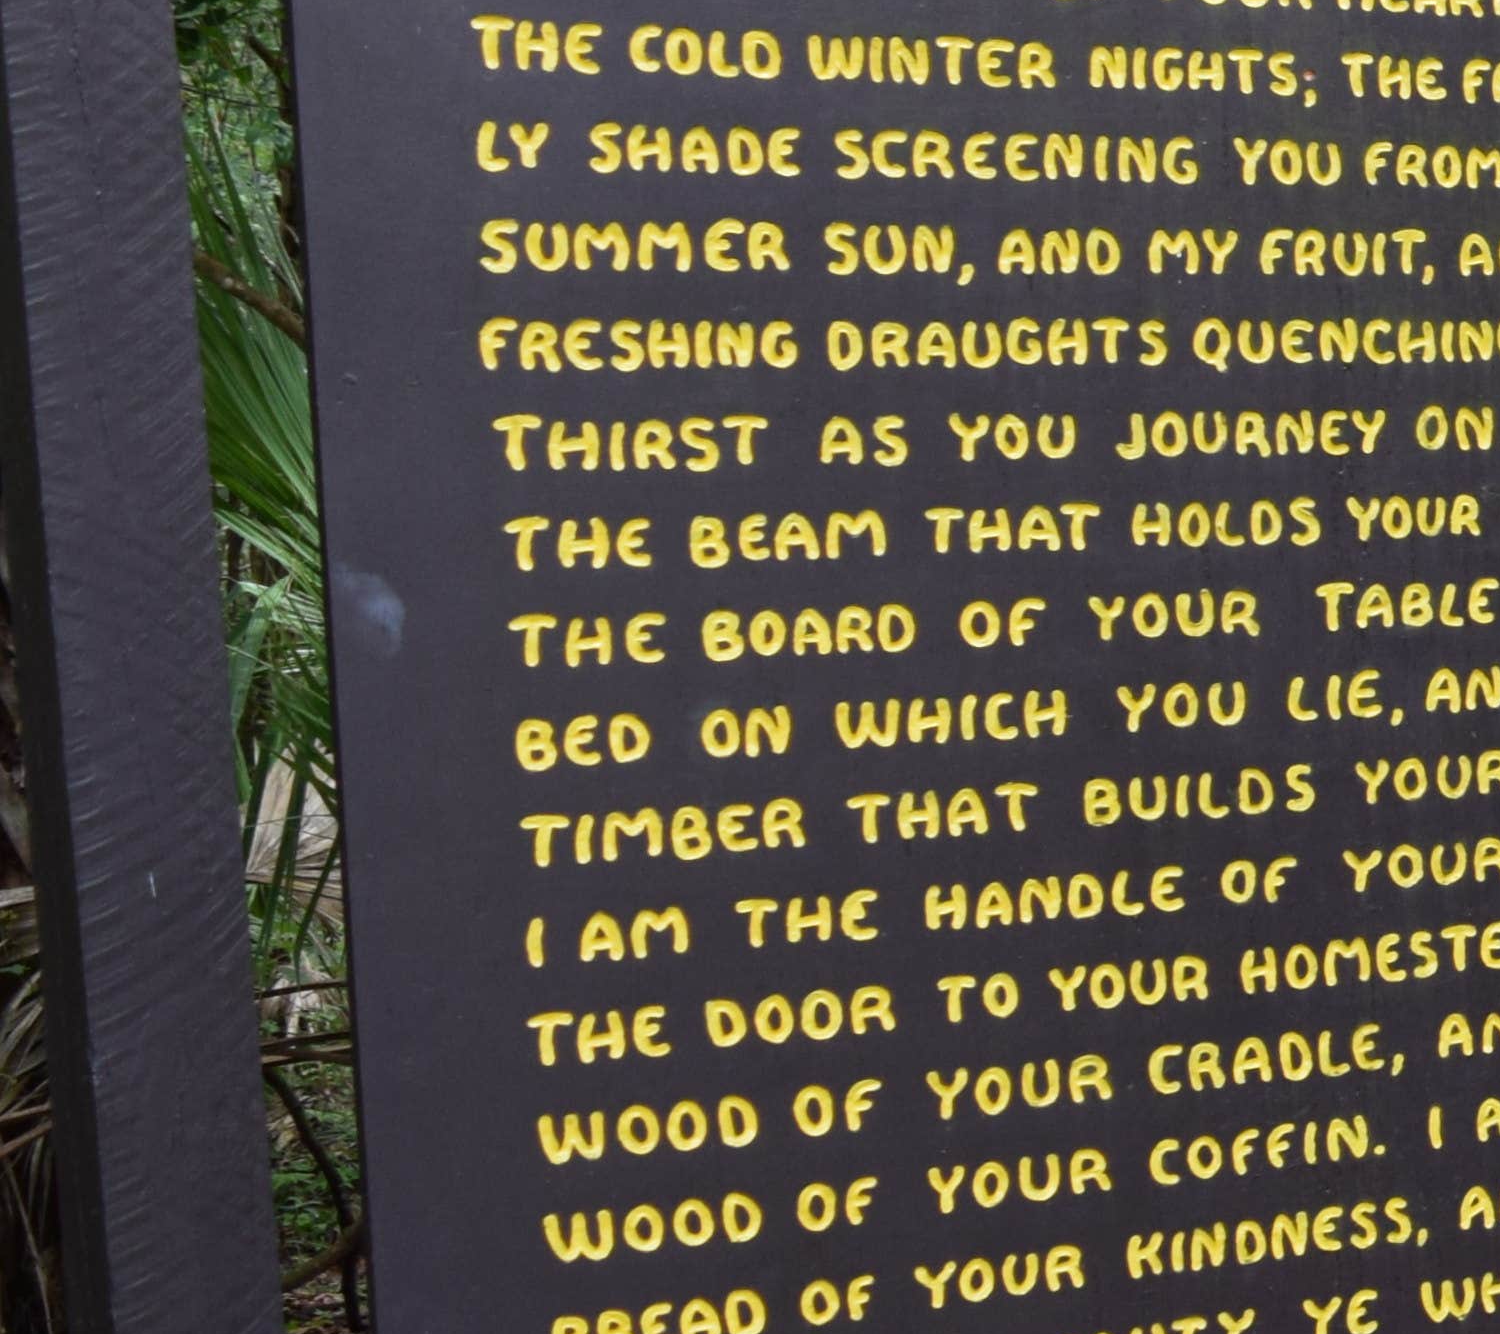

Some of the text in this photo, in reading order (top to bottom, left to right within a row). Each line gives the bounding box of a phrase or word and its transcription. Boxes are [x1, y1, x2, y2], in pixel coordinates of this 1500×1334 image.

[473, 13, 604, 71] THE
[628, 23, 784, 78] COLD
[806, 33, 1058, 87] WINTER
[1088, 45, 1318, 104] NIGHTS;
[1340, 51, 1447, 98] THE
[476, 120, 551, 171] LY
[588, 121, 802, 175] SHADE
[833, 128, 1200, 182] SCREENING
[1232, 137, 1343, 186] YOU
[480, 217, 791, 272] SUMMER
[823, 221, 976, 282] SUN,
[997, 227, 1122, 274] AND
[1146, 228, 1240, 273] MY
[1258, 228, 1436, 283] FRUIT,
[477, 316, 800, 369] FRESHING
[826, 316, 1169, 370] DRAUGHTS
[491, 413, 769, 472] THIRST
[818, 414, 909, 465] AS
[947, 412, 1077, 461] YOU
[1115, 409, 1386, 460] JOURNEY
[504, 515, 653, 568] THE
[688, 509, 888, 567] BEAM
[924, 502, 1102, 552] THAT
[1130, 496, 1322, 547] HOLDS
[1345, 494, 1481, 540] YOUR
[508, 612, 667, 667] THE
[700, 603, 917, 662] BOARD
[958, 597, 1047, 646] OF
[1088, 589, 1261, 640] YOUR
[514, 713, 652, 771] BED
[699, 705, 793, 756] ON
[834, 689, 1069, 749] WHICH
[1116, 681, 1247, 730] YOU
[1287, 668, 1404, 723] LIE,
[519, 797, 807, 865] TIMBER
[845, 782, 1039, 840] THAT
[1083, 763, 1316, 826] BUILDS
[524, 917, 546, 965] I
[579, 906, 690, 960] AM
[734, 889, 879, 947] THE
[924, 865, 1186, 930] HANDLE
[1220, 855, 1297, 903] OF
[527, 1004, 672, 1066] THE
[704, 985, 897, 1047] DOOR
[936, 972, 1019, 1023] TO
[1048, 955, 1209, 1010] YOUR
[536, 1095, 760, 1164] WOOD
[792, 1078, 882, 1137] OF
[925, 1054, 1114, 1119] YOUR
[1147, 1023, 1405, 1095] CRADLE,
[542, 1192, 763, 1262] WOOD
[796, 1176, 878, 1232] OF
[927, 1148, 1112, 1214] YOUR
[1148, 1115, 1386, 1186] COFFIN.
[1428, 1105, 1443, 1148] I
[799, 1274, 875, 1326] OF
[913, 1244, 1085, 1309] YOUR
[1126, 1197, 1428, 1279] KINDNESS,
